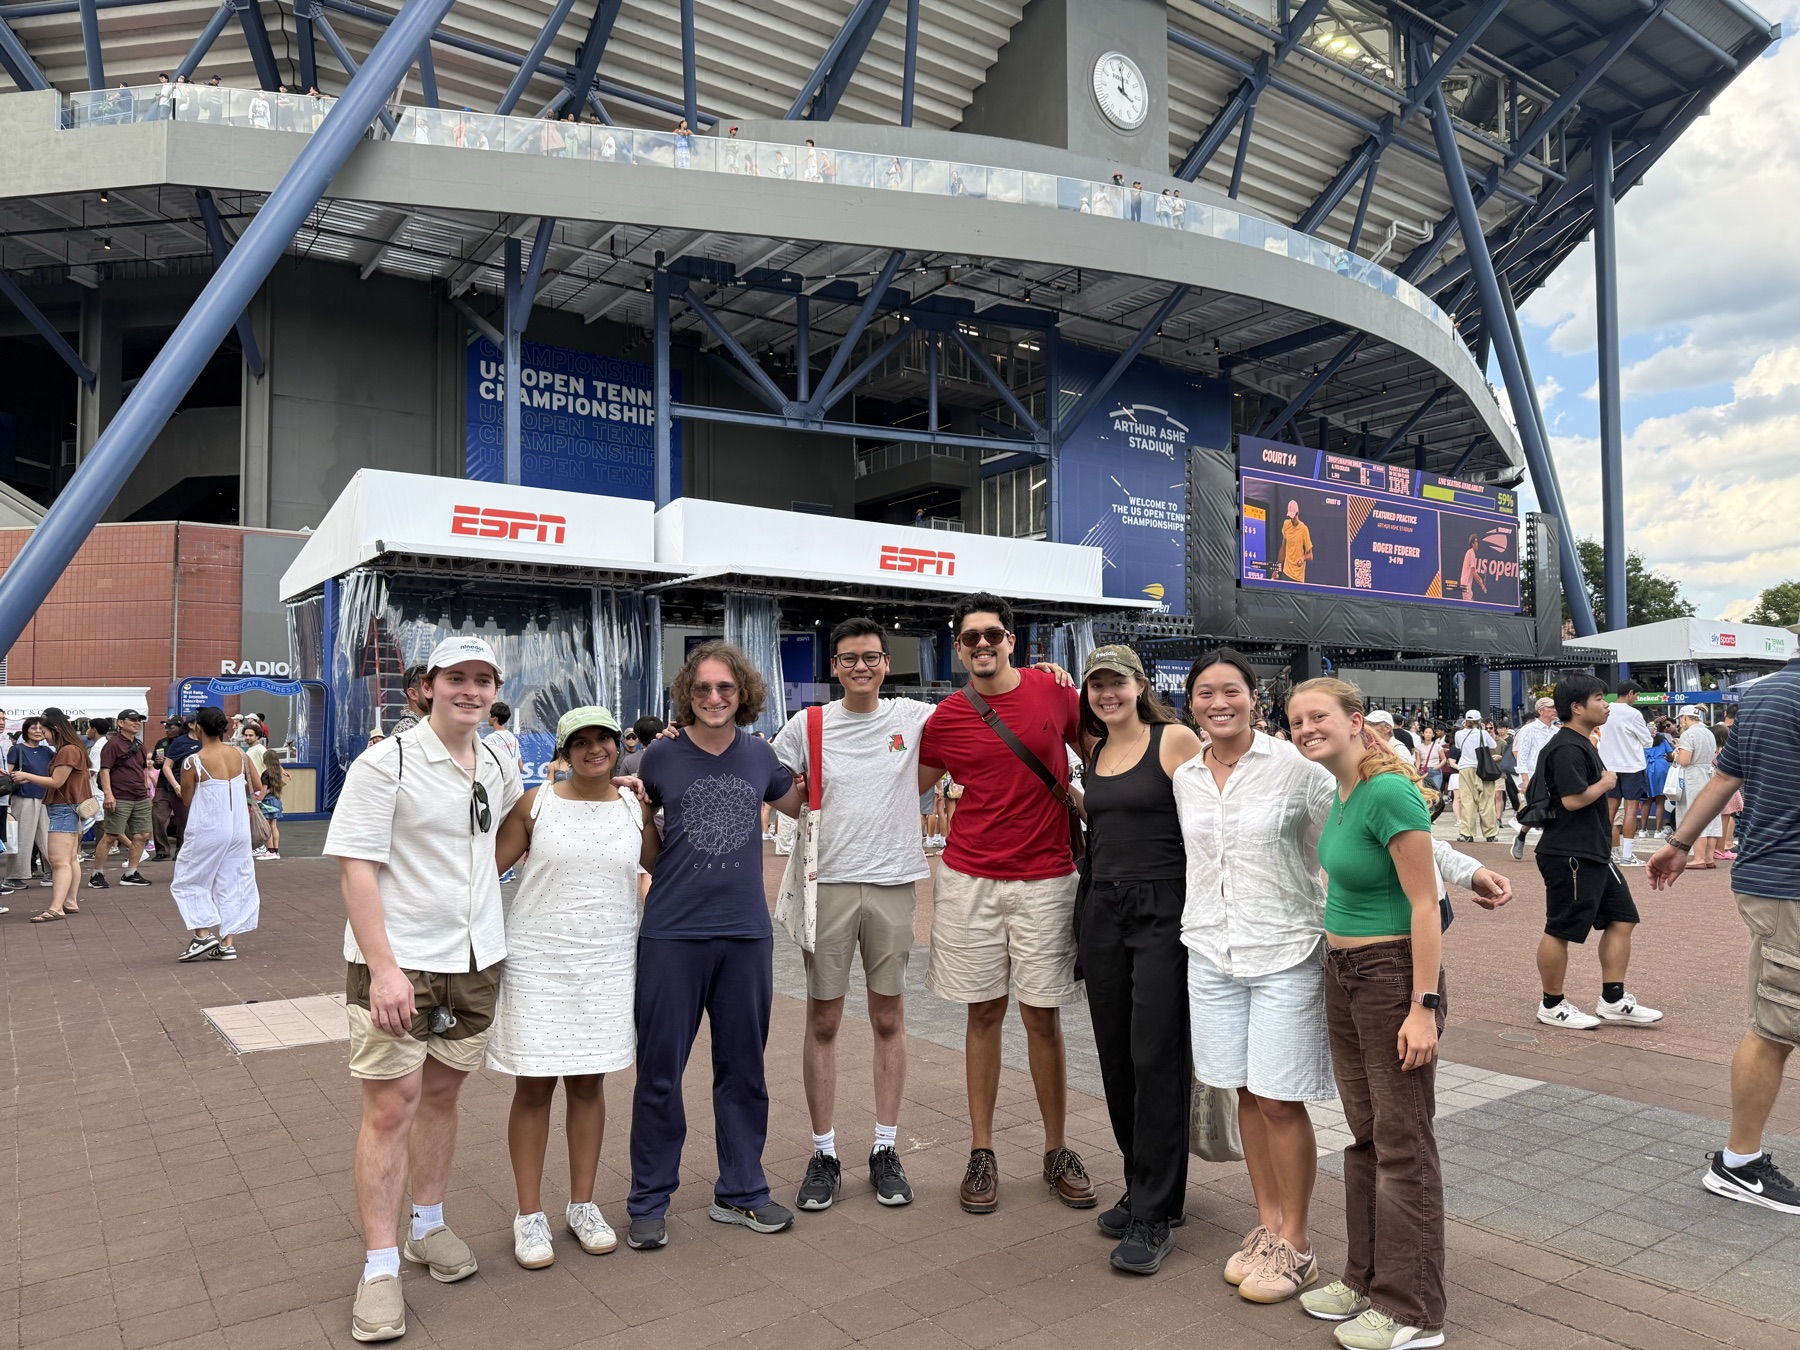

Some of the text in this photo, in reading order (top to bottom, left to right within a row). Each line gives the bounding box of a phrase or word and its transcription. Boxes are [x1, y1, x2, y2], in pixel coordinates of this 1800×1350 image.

[521, 368, 585, 396] OPEN
[593, 380, 672, 407] TENN
[521, 411, 585, 437] OPEN
[593, 422, 673, 449] TENN
[1114, 419, 1186, 443] ARTHUR ASHE
[1129, 436, 1174, 455] STADIUM
[521, 453, 585, 479] OPEN
[1262, 449, 1297, 467] COURT 14
[1129, 496, 1178, 512] WELCOME TO
[1497, 492, 1514, 507] 59%
[1112, 504, 1186, 523] THE US OPEN TENN
[1373, 509, 1418, 525] FEATURED PRACTICE
[451, 504, 566, 544] ESPN
[1122, 516, 1185, 532] CHAMPIONSHIPS
[1373, 541, 1420, 558] ROGER FEDERER
[879, 545, 956, 576] ESPN
[1475, 558, 1518, 581] us open
[1711, 634, 1735, 645] sky sports
[221, 660, 290, 676] RADIO
[215, 681, 296, 693] AMERICAN EXPRESS
